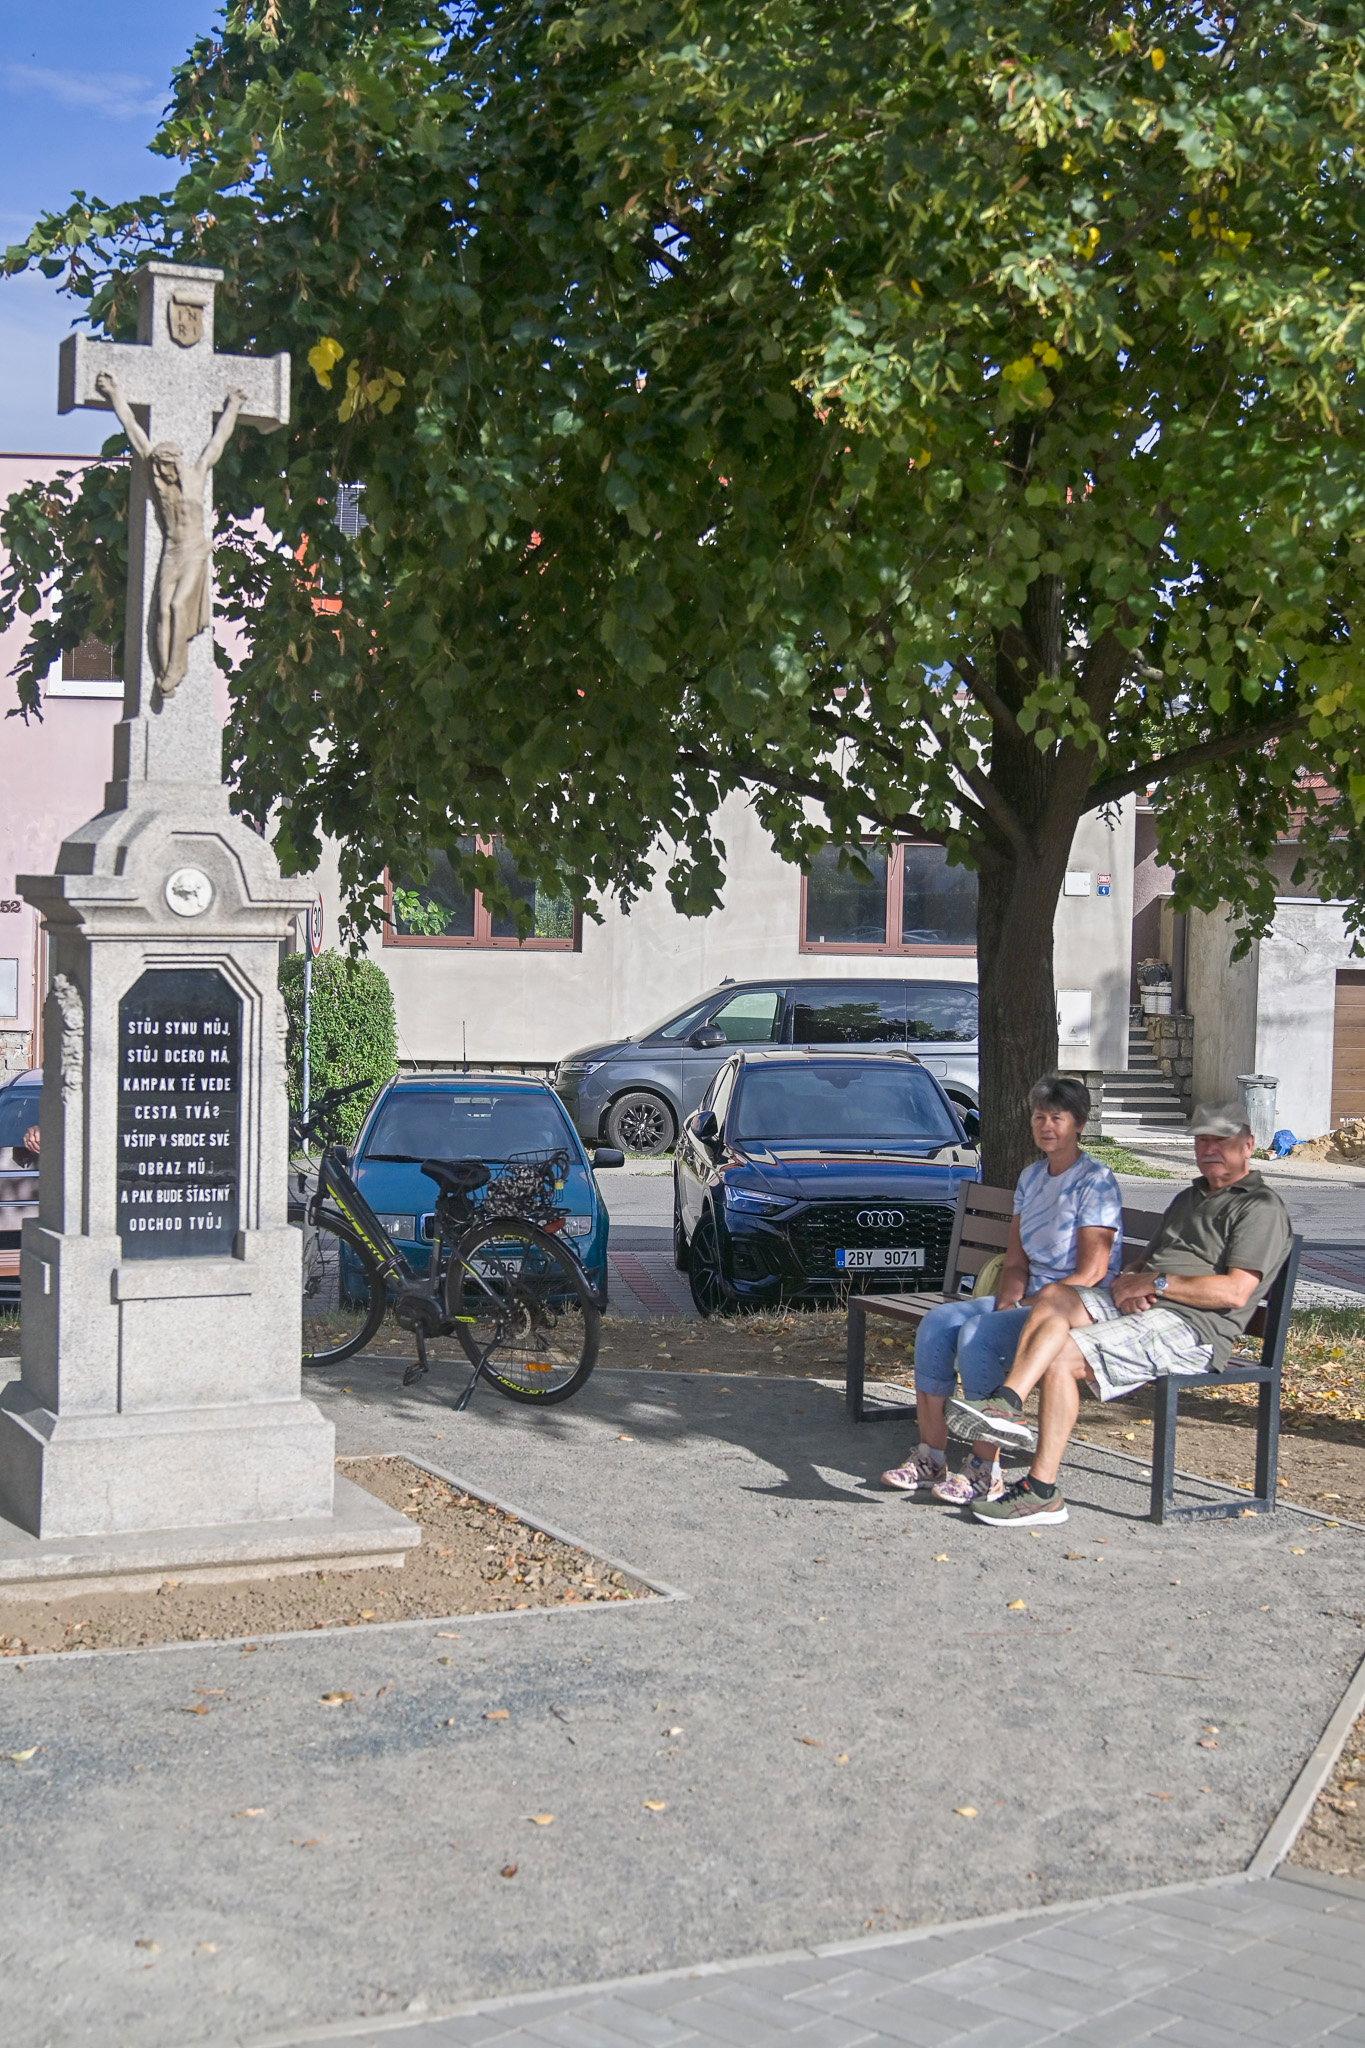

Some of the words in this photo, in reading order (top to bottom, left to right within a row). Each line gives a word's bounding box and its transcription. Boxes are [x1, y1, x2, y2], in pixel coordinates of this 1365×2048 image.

[314, 907, 321, 937] 30
[128, 1017, 159, 1035] STŮJ
[165, 1022, 198, 1035] SYNU
[127, 1045, 158, 1063] STŮJ
[164, 1049, 205, 1063] DCERO
[123, 1078, 175, 1091] KAMPAK
[181, 1074, 195, 1091] TĚ
[201, 1078, 231, 1091] VEDE
[134, 1106, 177, 1119] CESTA
[185, 1101, 220, 1119] TVÁ?
[123, 1129, 156, 1147] VŠTIP
[160, 1134, 167, 1147] V
[170, 1134, 206, 1147] SRDCE
[209, 1129, 230, 1147] SVÉ
[138, 1162, 181, 1175] OBRAZ
[120, 1191, 129, 1203] A
[131, 1190, 153, 1203] PAK
[156, 1190, 183, 1203] BUDE
[129, 1217, 182, 1231] ODCHOD
[189, 1212, 222, 1230] TVŮJ
[848, 1251, 873, 1266] 2BY
[884, 1251, 917, 1265] 9071
